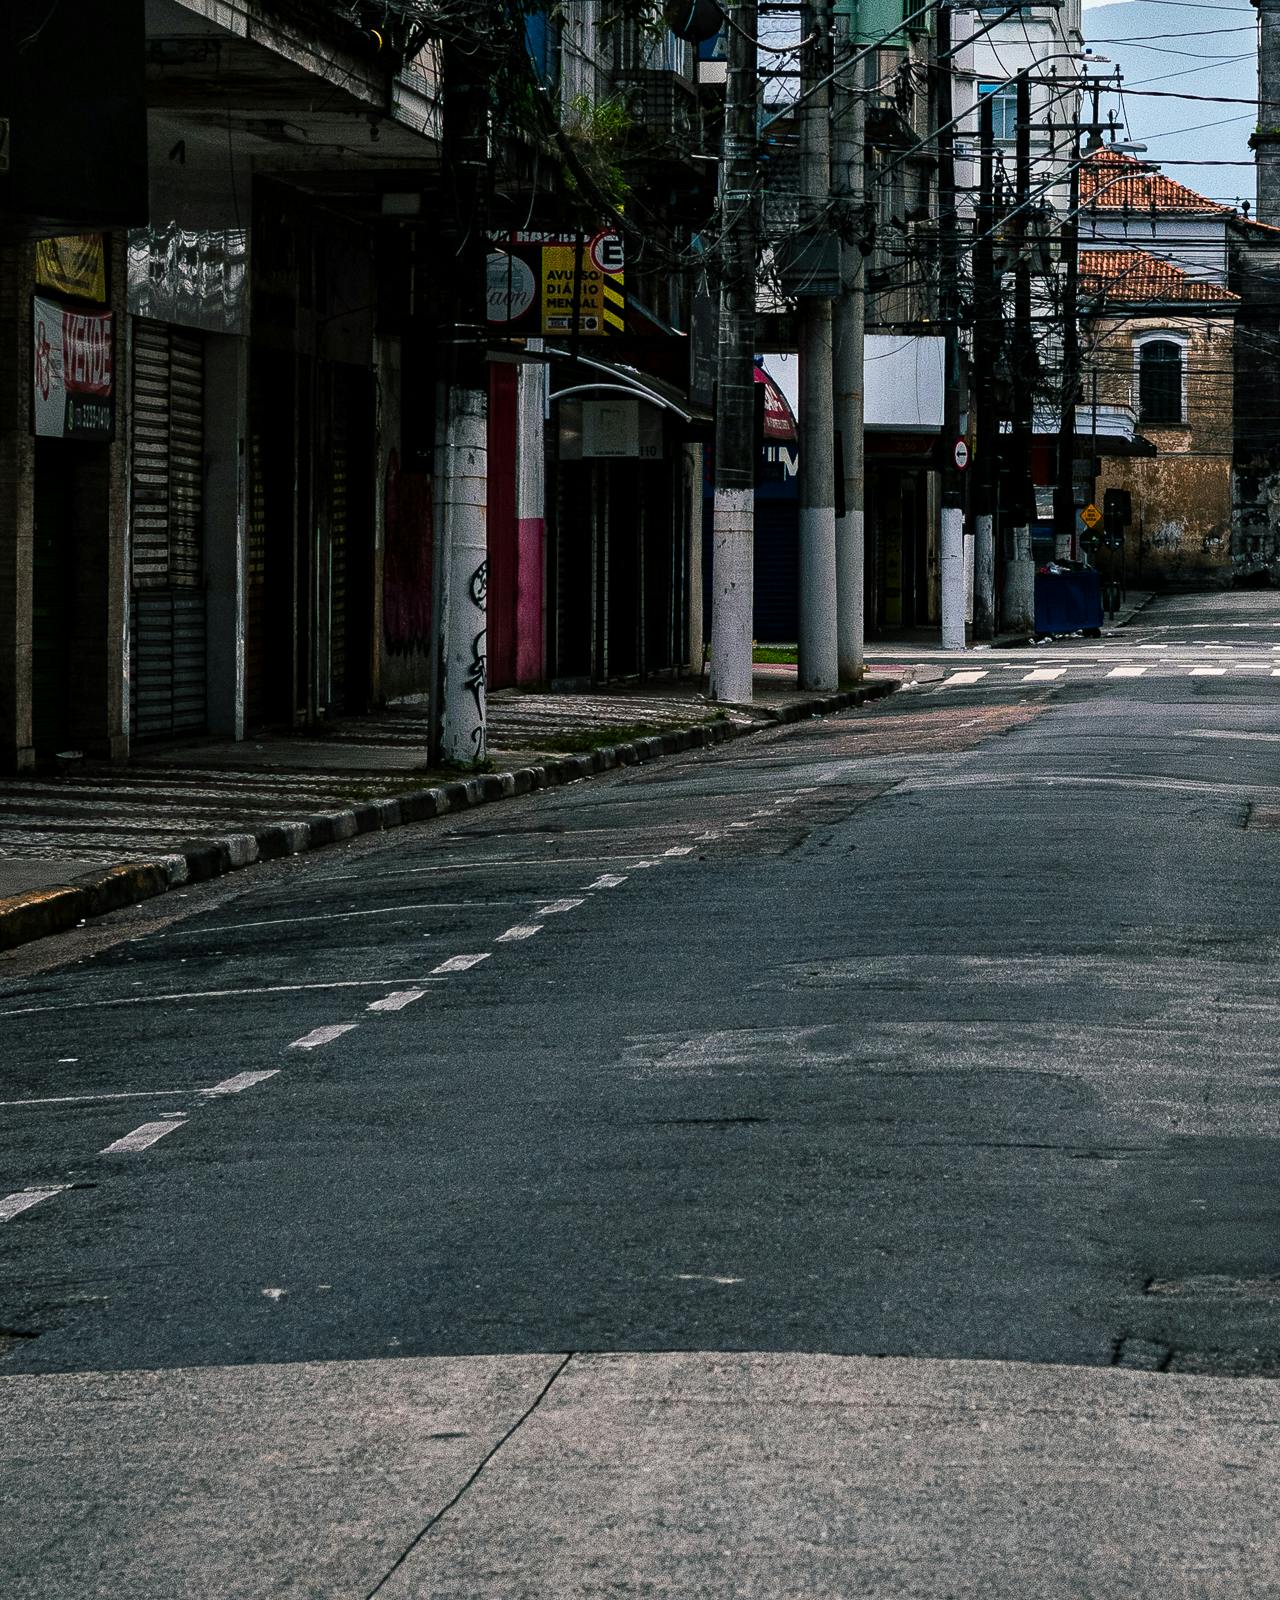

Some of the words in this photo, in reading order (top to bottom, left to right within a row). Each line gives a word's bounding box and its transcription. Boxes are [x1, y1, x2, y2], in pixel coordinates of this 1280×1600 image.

[603, 241, 622, 264] E
[547, 271, 598, 280] AVUSO
[547, 282, 598, 294] DIÁIO
[547, 299, 598, 308] MENAL
[66, 313, 111, 385] VENDE
